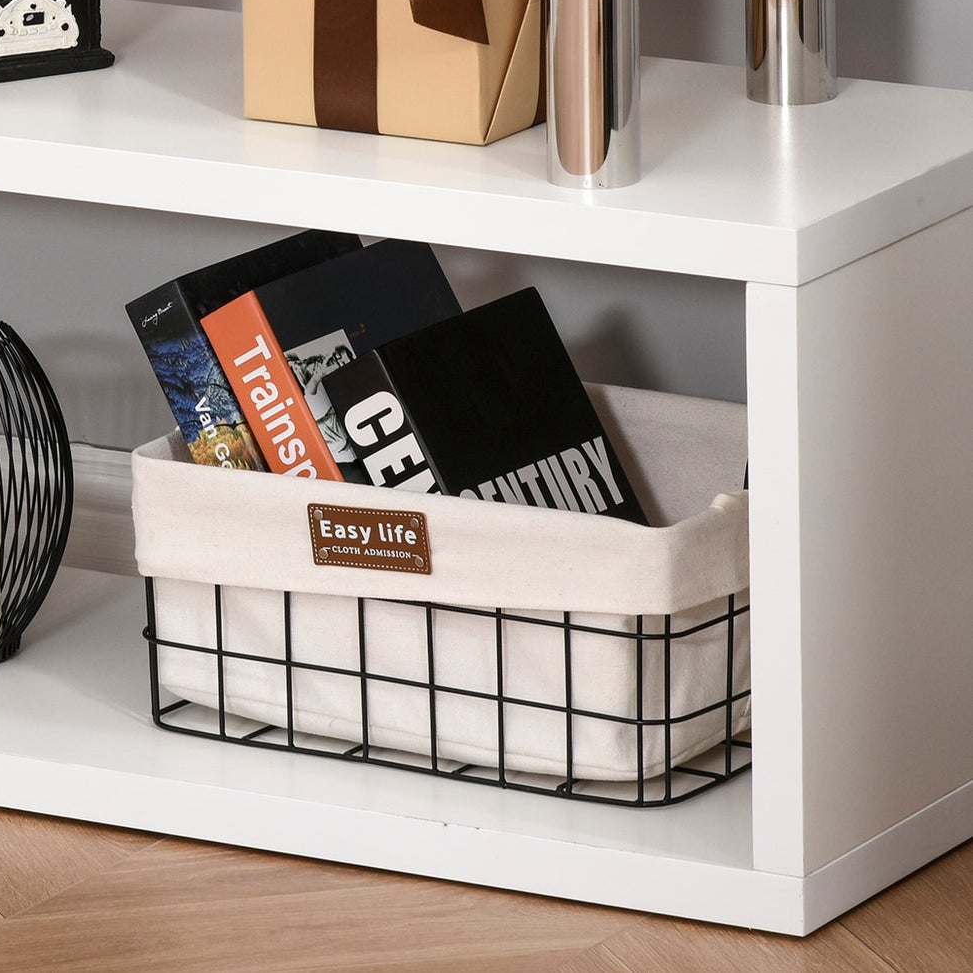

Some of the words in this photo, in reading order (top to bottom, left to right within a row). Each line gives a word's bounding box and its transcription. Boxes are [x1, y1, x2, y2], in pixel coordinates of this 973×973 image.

[194, 396, 219, 440] Van
[320, 520, 371, 545] Easy
[378, 522, 417, 545] life
[332, 545, 361, 555] CLOTH
[364, 548, 412, 559] ADMISSION
